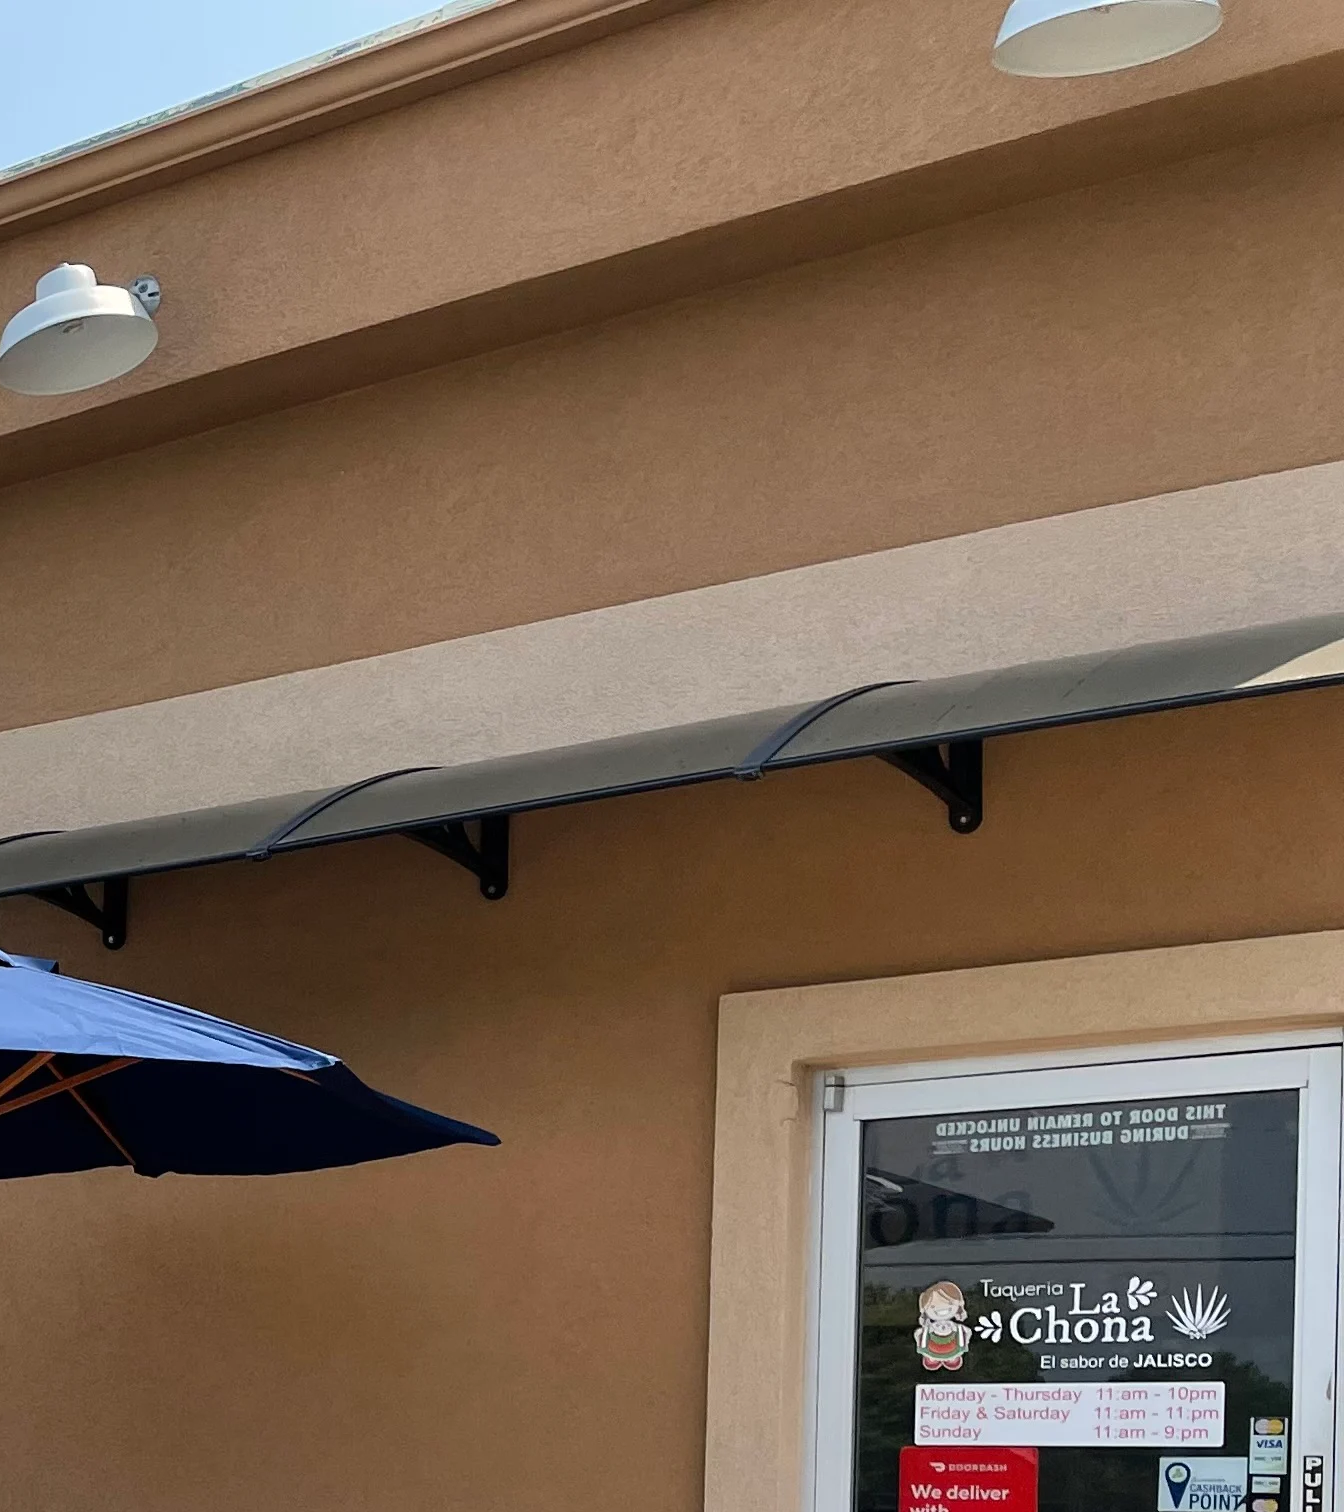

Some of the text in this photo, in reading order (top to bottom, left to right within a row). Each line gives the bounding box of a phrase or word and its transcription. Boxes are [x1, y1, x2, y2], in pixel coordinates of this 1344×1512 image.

[979, 1279, 1120, 1315] Taqueria La
[1009, 1305, 1155, 1344] Chona
[1040, 1352, 1213, 1369] El sabor de JALISCO
[920, 1388, 986, 1405] Monday
[1002, 1387, 1083, 1403] Thursday
[1168, 1386, 1218, 1403] 10pm
[920, 1406, 971, 1422] Friday
[976, 1407, 988, 1420] &
[994, 1406, 1071, 1423] Saturday
[1166, 1406, 1219, 1422] 11:pm
[919, 1425, 982, 1441] Sunday
[1164, 1425, 1209, 1441] 9:pm
[1256, 1439, 1284, 1449] VISA
[949, 1463, 1008, 1472] DOORDASH
[911, 1484, 1010, 1501] We deliver
[1190, 1484, 1242, 1494] CASHBACK
[1189, 1493, 1242, 1511] POINT
